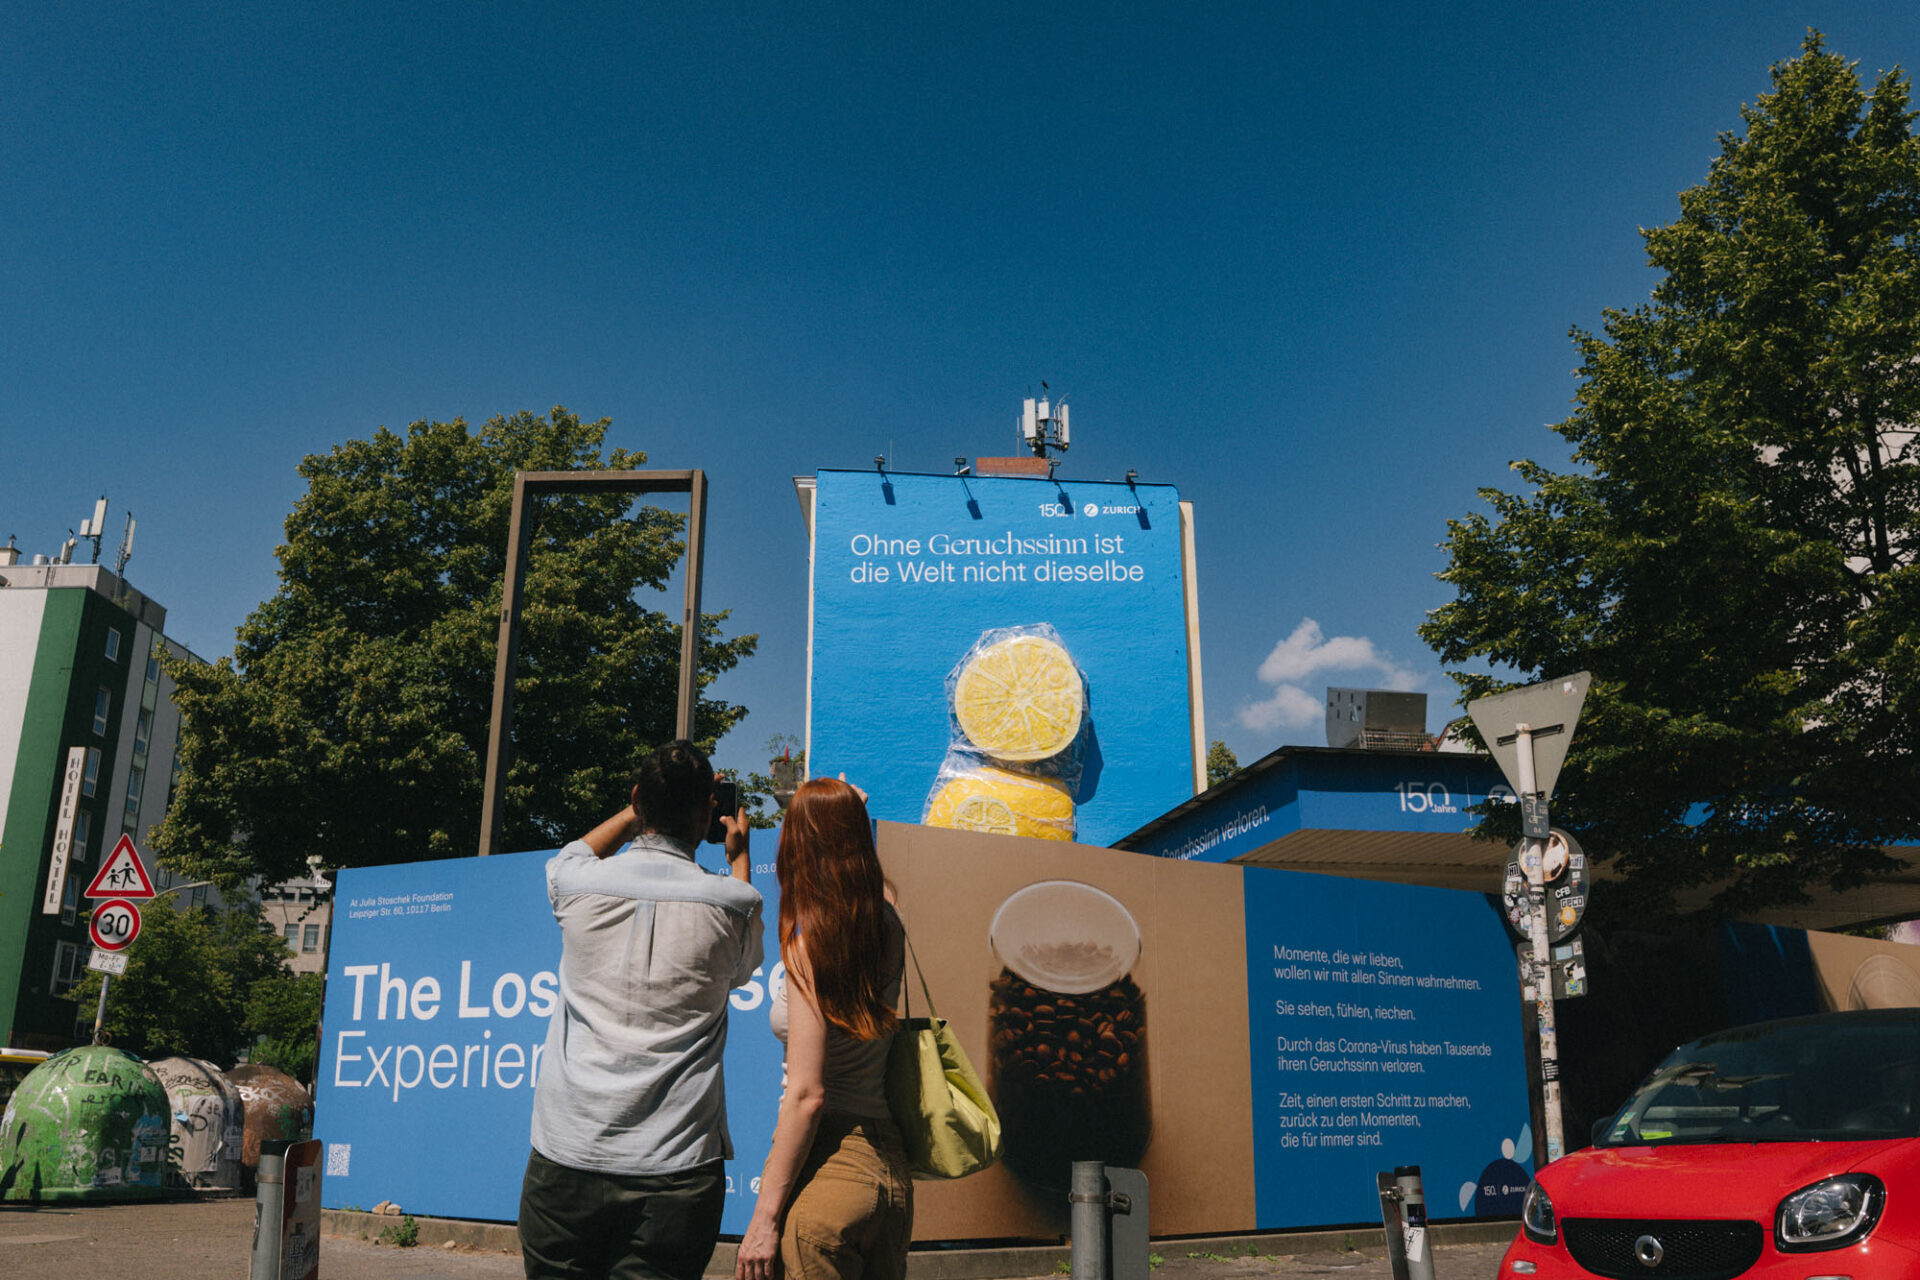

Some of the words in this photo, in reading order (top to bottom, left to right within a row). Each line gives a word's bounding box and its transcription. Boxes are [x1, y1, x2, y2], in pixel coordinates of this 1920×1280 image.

[851, 534, 921, 556] Ohne
[928, 531, 1088, 555] Geruchssinn
[1094, 533, 1125, 554] ist
[850, 561, 889, 583] die
[897, 560, 956, 582] Welt
[963, 561, 1027, 582] nicht
[1034, 559, 1144, 582] dieselbe
[62, 757, 80, 820] HOTEL
[1393, 781, 1450, 813] 150
[1431, 804, 1457, 814] Jahre
[1221, 804, 1270, 842] verloren.
[49, 829, 69, 905] HOSTEL
[755, 862, 777, 874] 03.0
[349, 910, 379, 919] Leipziger
[380, 907, 392, 916] Str.
[406, 904, 429, 914] 10117
[430, 903, 452, 912] Berlin
[360, 898, 376, 907] Julia
[377, 894, 411, 906] Stoschek
[412, 892, 454, 903] Foundation
[100, 912, 130, 937] 30
[1274, 945, 1331, 965] Momente,
[1332, 950, 1350, 964] die
[1352, 953, 1367, 965] wir
[1370, 952, 1404, 969] lieben,
[1274, 965, 1311, 980] wollen
[1313, 968, 1330, 981] wir
[1332, 969, 1349, 982] mit
[1351, 970, 1376, 984] allen
[1377, 970, 1415, 986] Sinnen
[1416, 974, 1482, 990] wahrnehmen.
[343, 962, 441, 1021] The
[458, 960, 559, 1019] Los
[1276, 1000, 1295, 1016] Sie
[1297, 1001, 1335, 1019] sehen,
[1337, 1003, 1373, 1020] fühlen,
[1375, 1005, 1416, 1020] riechen.
[1278, 1036, 1313, 1052] Durch
[1315, 1038, 1336, 1053] das
[1338, 1038, 1408, 1054] Corona-Virus
[1409, 1041, 1442, 1055] haben
[1443, 1041, 1492, 1056] Tausende
[334, 1029, 545, 1103] Experie
[1278, 1056, 1308, 1071] ihren
[1310, 1056, 1379, 1072] Geruchssinn
[1380, 1059, 1425, 1073] verloren.
[1279, 1092, 1304, 1109] Zeit,
[1306, 1094, 1338, 1108] einen
[1340, 1094, 1375, 1108] ersten
[1376, 1092, 1412, 1108] Schritt
[1413, 1096, 1426, 1107] zu
[1428, 1093, 1472, 1109] machen,
[1280, 1112, 1318, 1128] zurück
[1320, 1115, 1334, 1127] zu
[1336, 1112, 1358, 1127] den
[1360, 1111, 1422, 1128] Momenten,
[1281, 1132, 1300, 1148] die
[1302, 1131, 1318, 1147] für
[1319, 1132, 1355, 1147] immer
[1357, 1130, 1383, 1146] sind.
